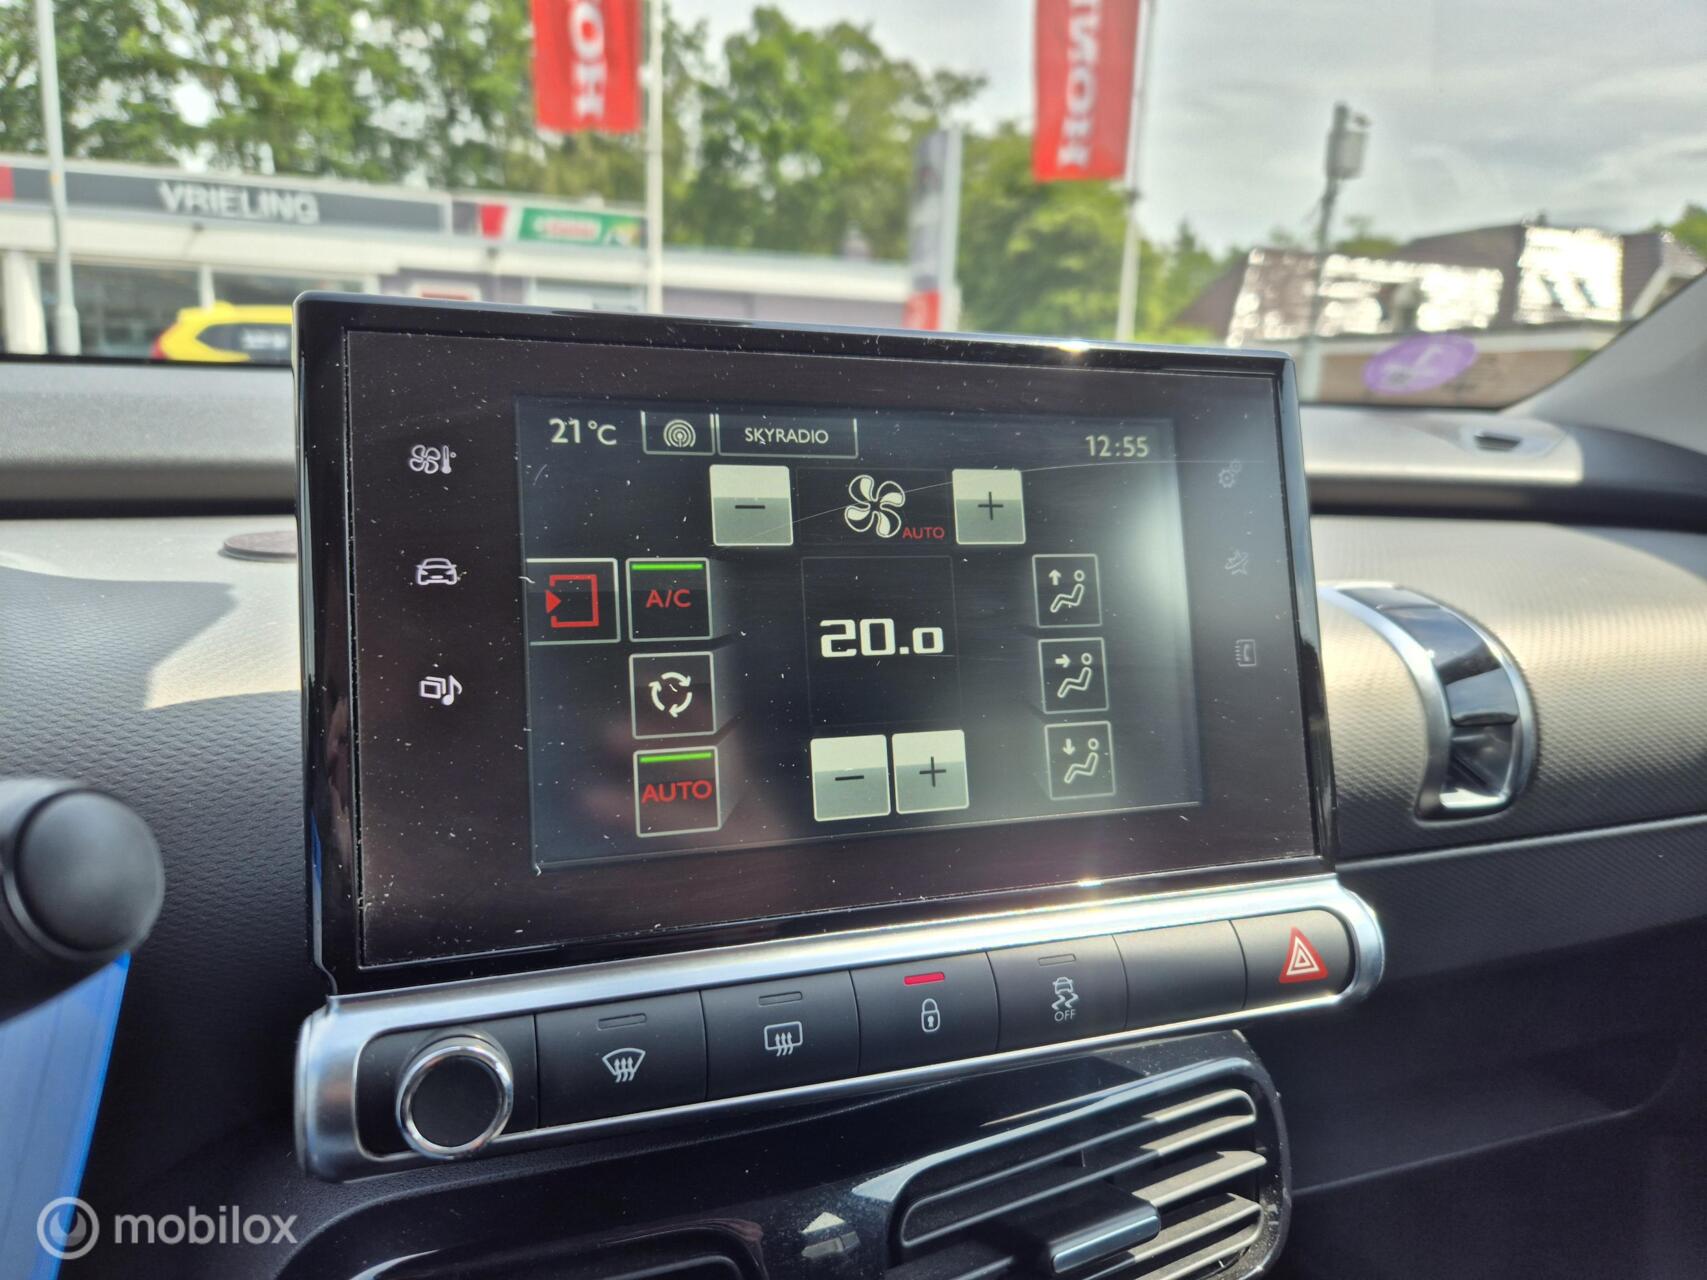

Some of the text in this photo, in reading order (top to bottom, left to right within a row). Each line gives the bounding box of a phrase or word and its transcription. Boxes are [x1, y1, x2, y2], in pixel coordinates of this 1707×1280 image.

[158, 182, 320, 225] VRIELING
[744, 427, 829, 444] SKYRADIO
[1086, 434, 1149, 458] 12:55
[902, 526, 945, 541] AUTO
[646, 588, 691, 609] A/C
[820, 618, 944, 658] 20.0
[641, 779, 713, 804] AUTO
[1054, 1009, 1077, 1022] OFF
